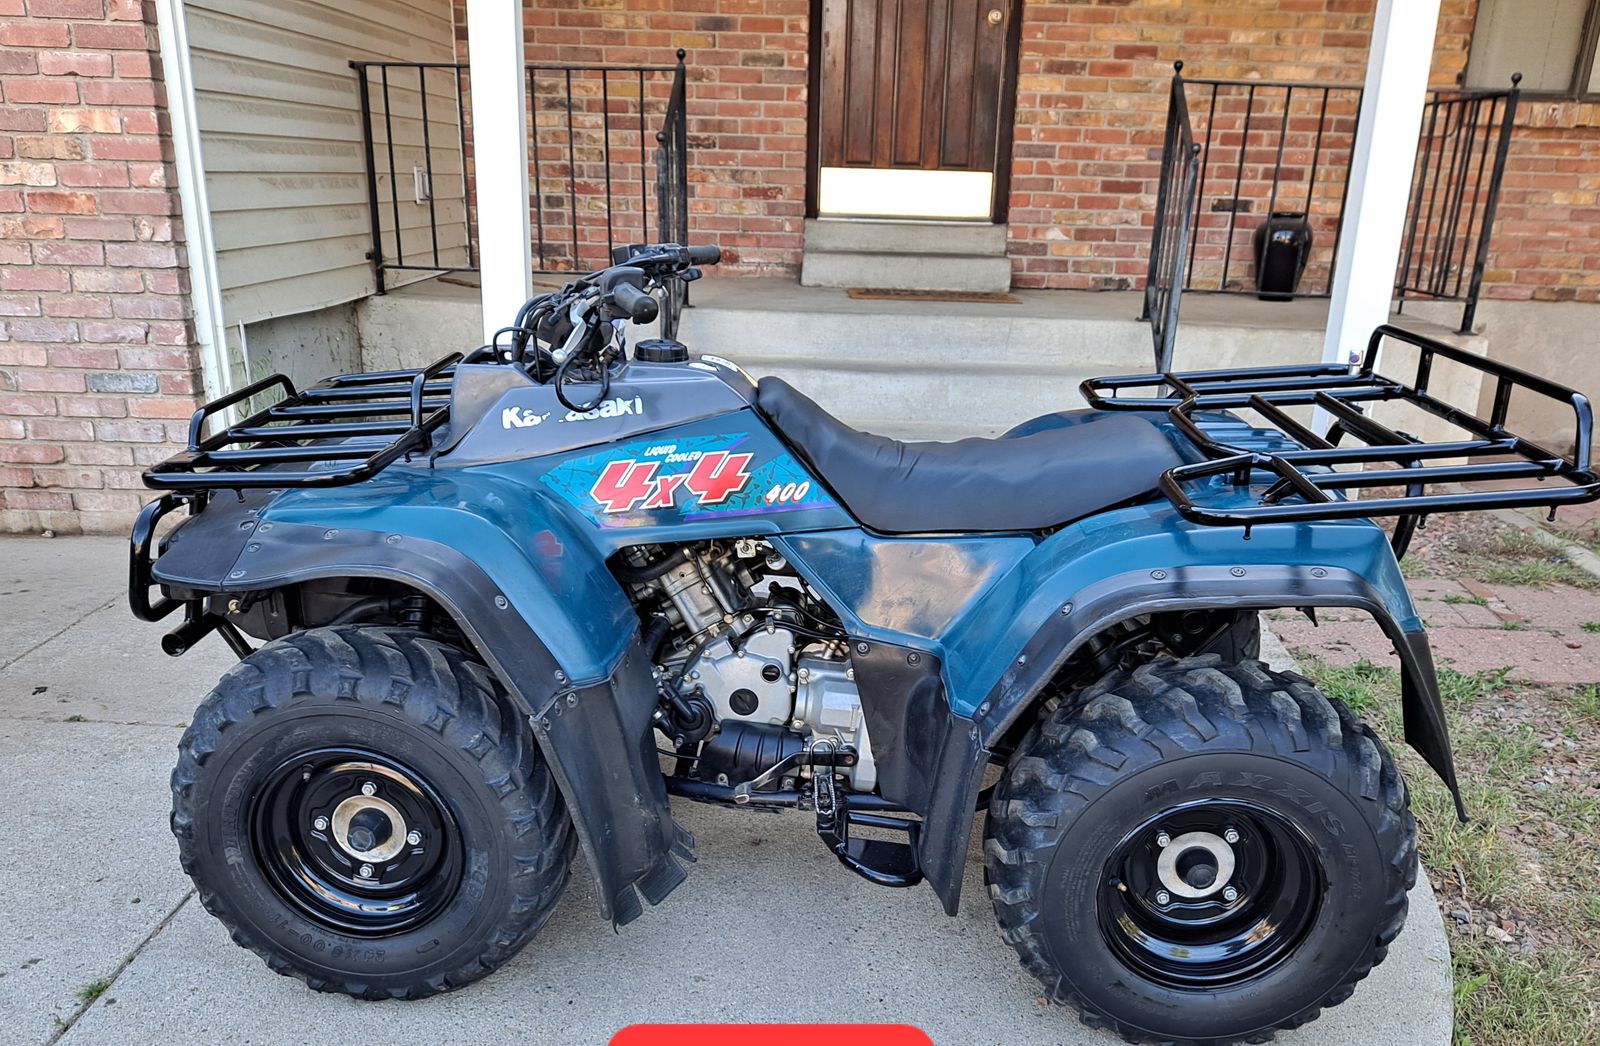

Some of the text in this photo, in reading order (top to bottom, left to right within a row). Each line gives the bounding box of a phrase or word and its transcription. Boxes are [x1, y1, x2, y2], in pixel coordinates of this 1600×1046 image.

[501, 395, 643, 429] Kaasaki
[644, 444, 677, 457] LIQUID
[664, 451, 702, 463] COOLED
[765, 481, 810, 504] 400
[1144, 770, 1347, 837] MAXXIS
